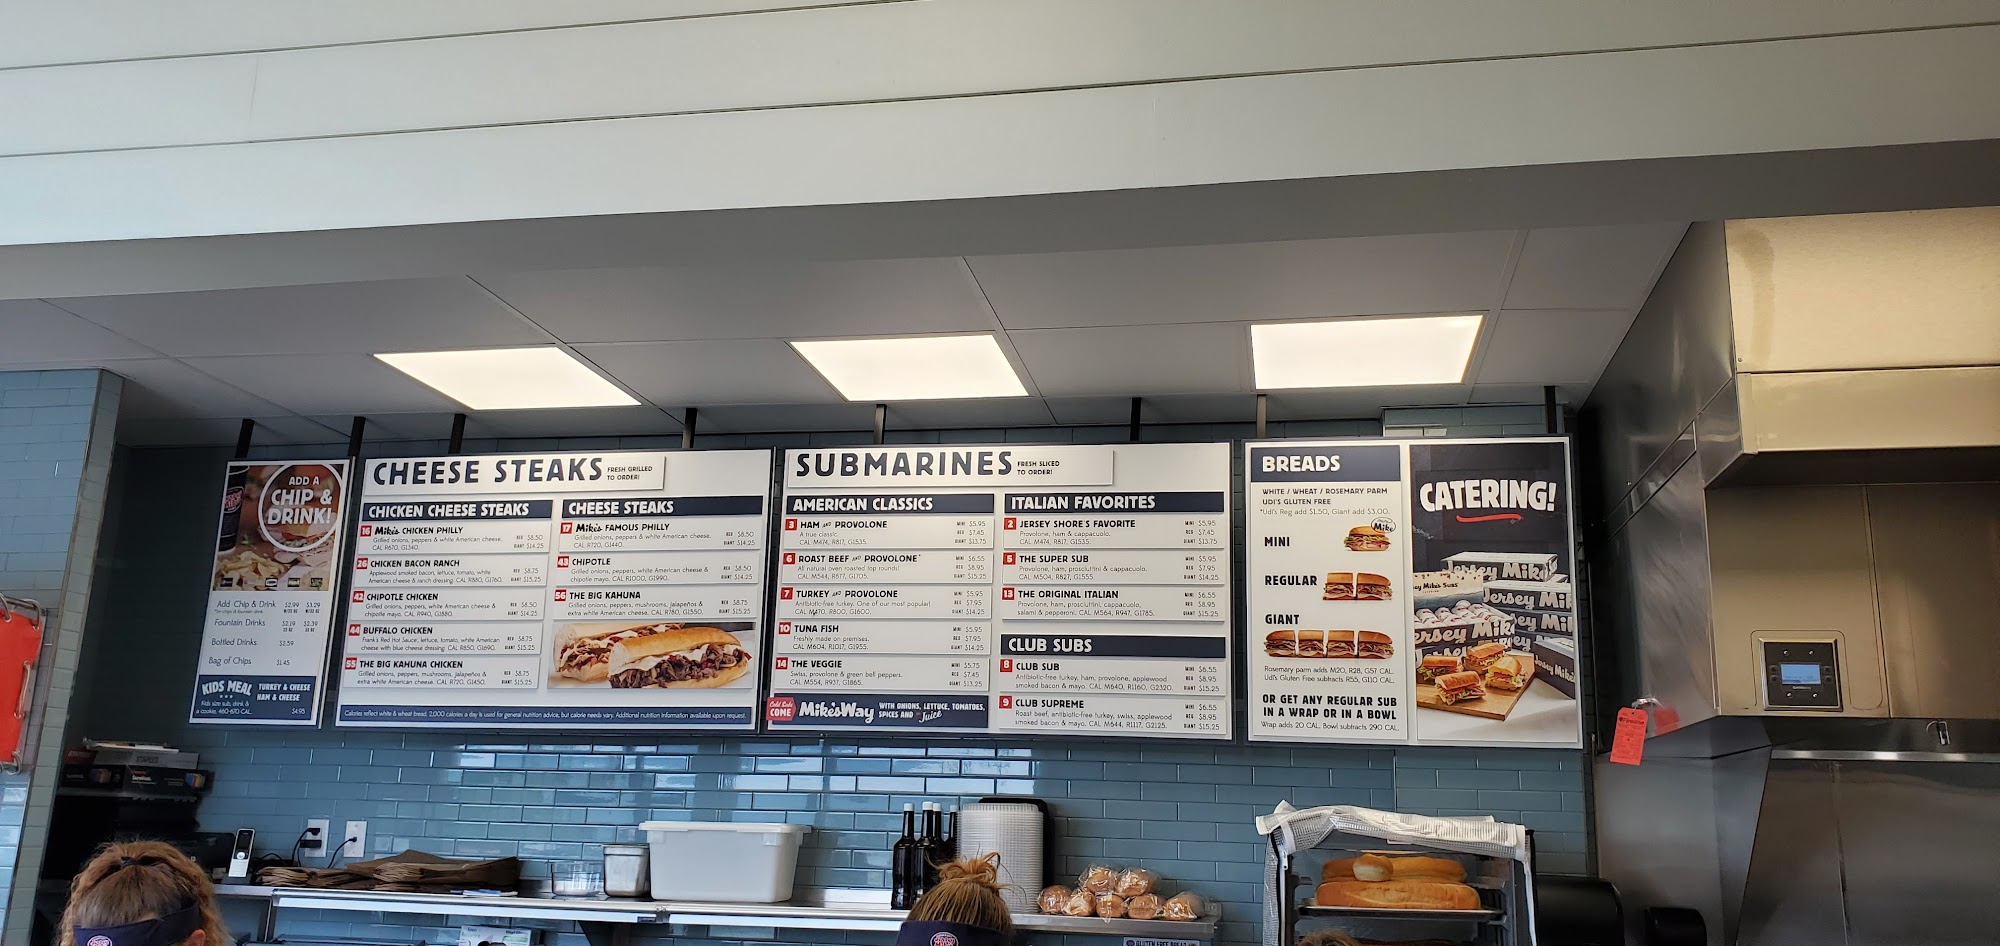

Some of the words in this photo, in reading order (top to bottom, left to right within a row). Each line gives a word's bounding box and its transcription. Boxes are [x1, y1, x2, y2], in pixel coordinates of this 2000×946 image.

[797, 452, 1012, 476] SUBMARINES
[1262, 455, 1340, 472] BREADS
[374, 461, 479, 485] CHEESE
[495, 457, 602, 482] STEAKS
[289, 477, 309, 485] ADD
[313, 476, 319, 485] A
[272, 489, 314, 506] CHIP
[320, 489, 332, 504] &
[1420, 479, 1556, 512] CATERING!
[569, 502, 619, 514] CHEESE
[624, 501, 674, 513] STEAKS
[793, 498, 867, 511] AMERICAN
[873, 498, 932, 510] CLASSICS
[1011, 496, 1069, 510] ITALIAN
[1075, 496, 1155, 509] FAVORITES
[369, 505, 423, 518] CHICKEN
[428, 504, 476, 517] CHEESE
[481, 503, 529, 516] STEAKS
[1309, 508, 1329, 516] $1.50,
[1367, 508, 1390, 516] $3.00.
[268, 508, 331, 525] DRINK!
[576, 524, 602, 532] Mike's
[801, 521, 820, 529] HAM
[1008, 520, 1013, 528] 2
[1020, 520, 1050, 528] JERSEY
[1054, 520, 1090, 528] SHORE'S
[1093, 520, 1136, 528] FAVORITE
[375, 526, 400, 535] Mike's
[1264, 537, 1290, 547] MINI
[358, 560, 367, 568] 26
[371, 560, 402, 568] CHICKEN
[1007, 555, 1012, 563] 5
[1020, 555, 1036, 563] THE
[1040, 555, 1068, 563] SUPER
[1071, 555, 1089, 563] SUB
[1264, 576, 1317, 586] REGULAR
[367, 593, 404, 601] CHIPOTLE
[797, 590, 829, 598] TURKEY
[845, 590, 898, 598] PROVOLONE
[1003, 590, 1013, 598] 13
[1018, 590, 1035, 598] THE
[1038, 590, 1081, 598] ORIGINAL
[1085, 590, 1118, 598] ITALIAN
[1265, 614, 1299, 625] GIANT
[349, 626, 360, 634] 44
[1009, 638, 1047, 652] CLUB
[1053, 639, 1092, 652] SUBS
[209, 657, 221, 666] Bag
[233, 657, 251, 666] Chips
[346, 660, 356, 668] 55
[1016, 662, 1038, 670] CLUB
[1042, 663, 1059, 671] SUB
[202, 681, 224, 695] KIDS
[227, 681, 253, 696] MEAL
[1003, 698, 1009, 706] 9
[1016, 699, 1038, 707] CLUB
[1041, 700, 1084, 708] SUPREME
[1262, 695, 1276, 703] OR
[1280, 695, 1298, 704] GET
[1302, 696, 1322, 705] ANY
[1328, 696, 1373, 706] REGULAR
[1378, 697, 1397, 706] SUB
[952, 703, 985, 711] TOMATOES,
[919, 711, 942, 723] Juice
[1264, 707, 1273, 716] IN
[1278, 708, 1284, 716] A
[1289, 708, 1318, 718] WRAP
[1324, 709, 1337, 718] OR
[1342, 709, 1352, 718] IN
[1356, 710, 1363, 719] A
[1368, 710, 1396, 720] BOWL
